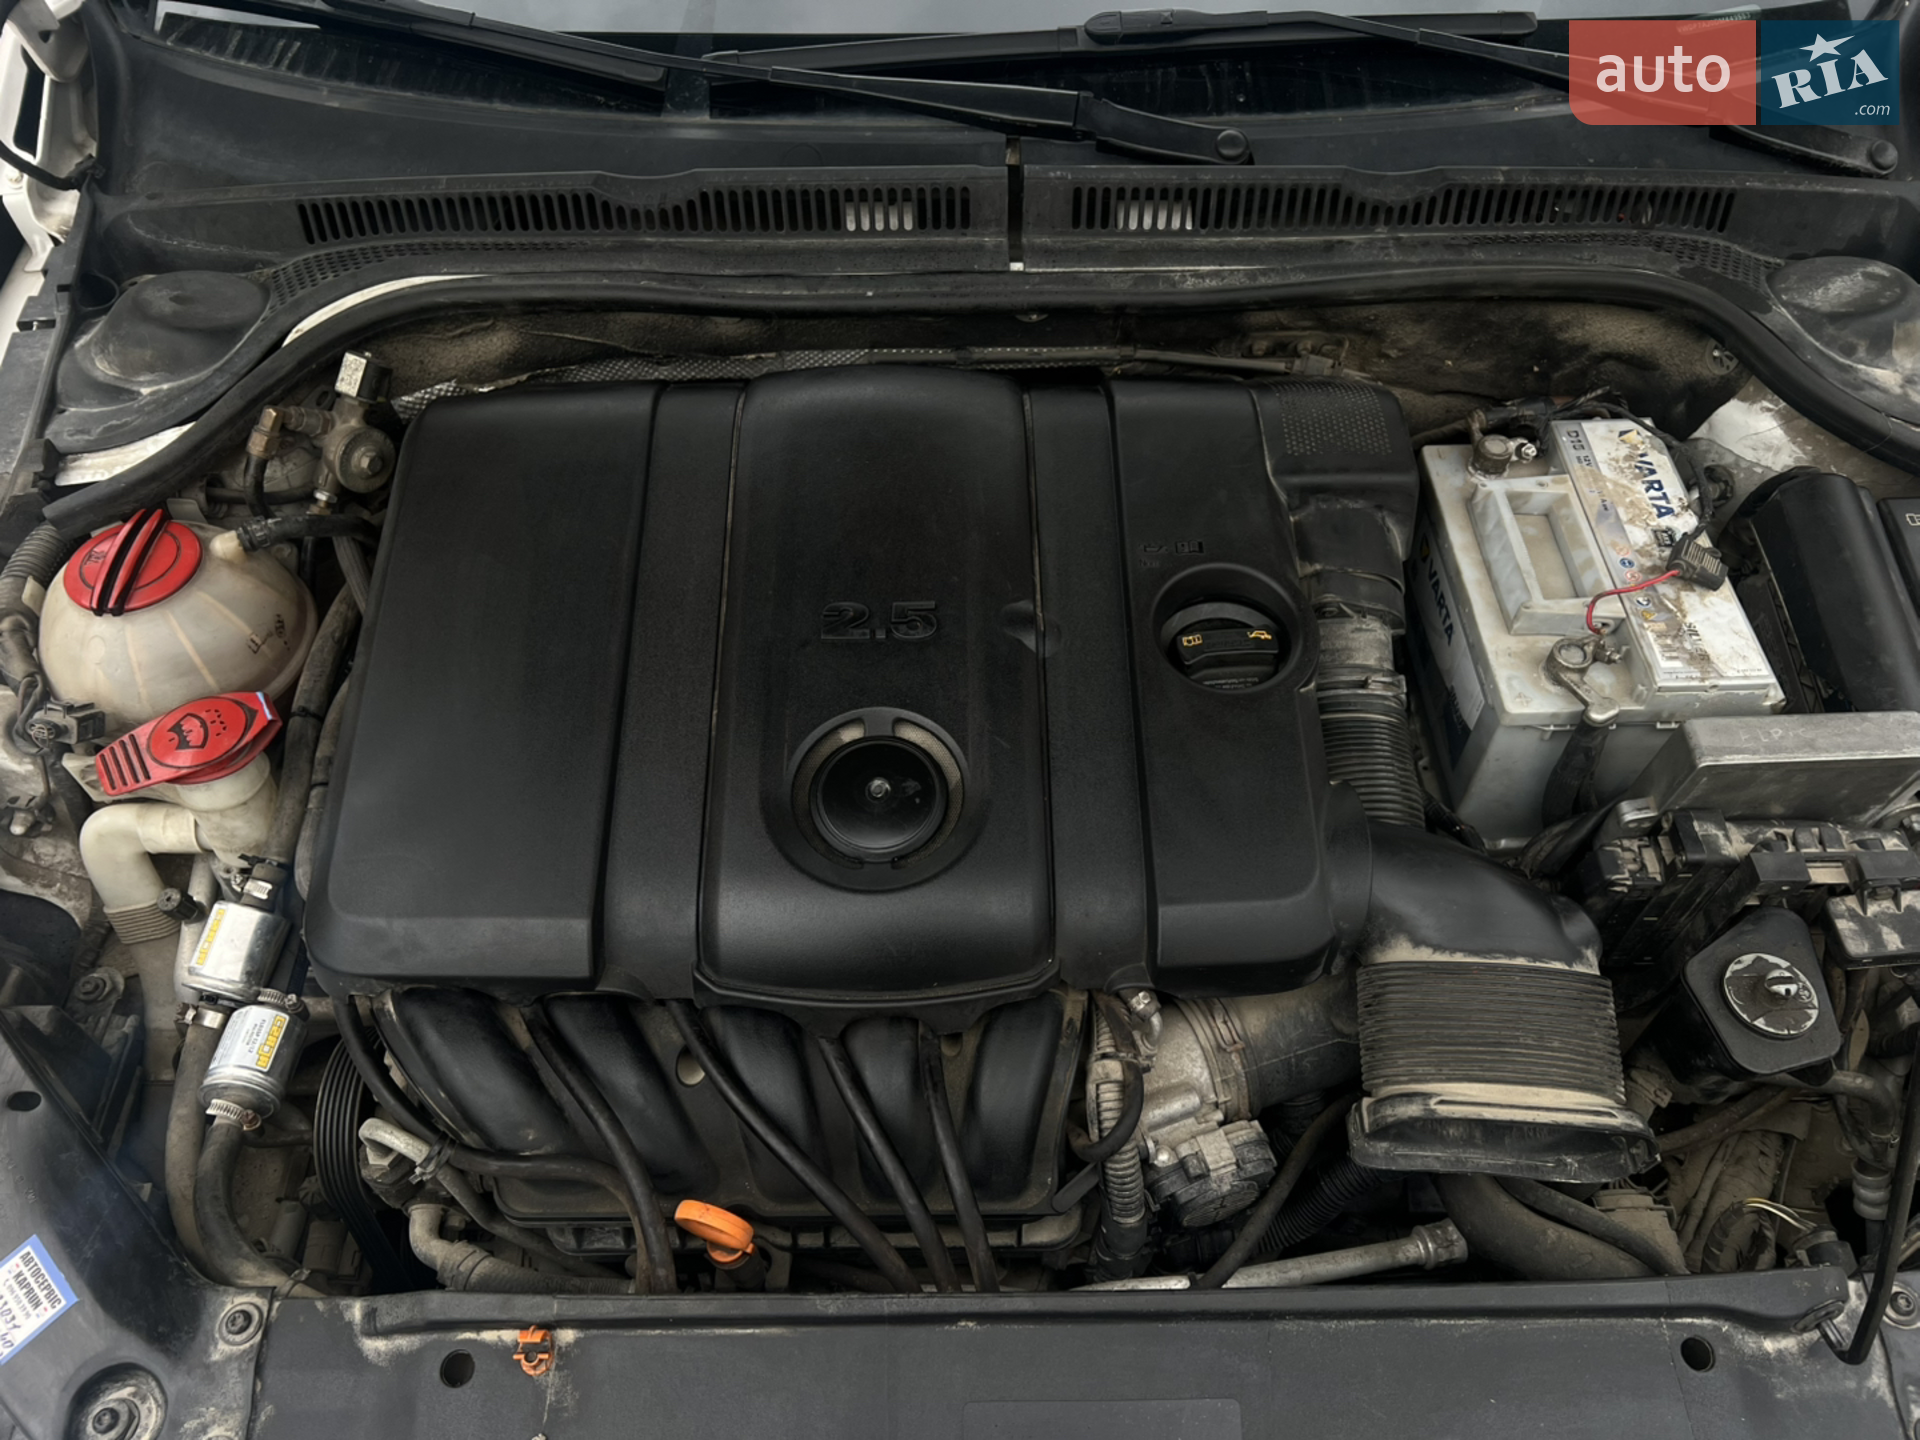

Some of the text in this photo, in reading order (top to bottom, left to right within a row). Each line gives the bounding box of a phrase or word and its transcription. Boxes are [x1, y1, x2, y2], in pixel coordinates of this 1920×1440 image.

[1566, 430, 1586, 451] D15
[1634, 452, 1676, 519] VARTA
[820, 601, 938, 639] 2.5
[1427, 557, 1454, 647] VARTA
[12, 1269, 44, 1311] KAPRUN
[19, 1250, 62, 1310] АВТОСЕРВІС
